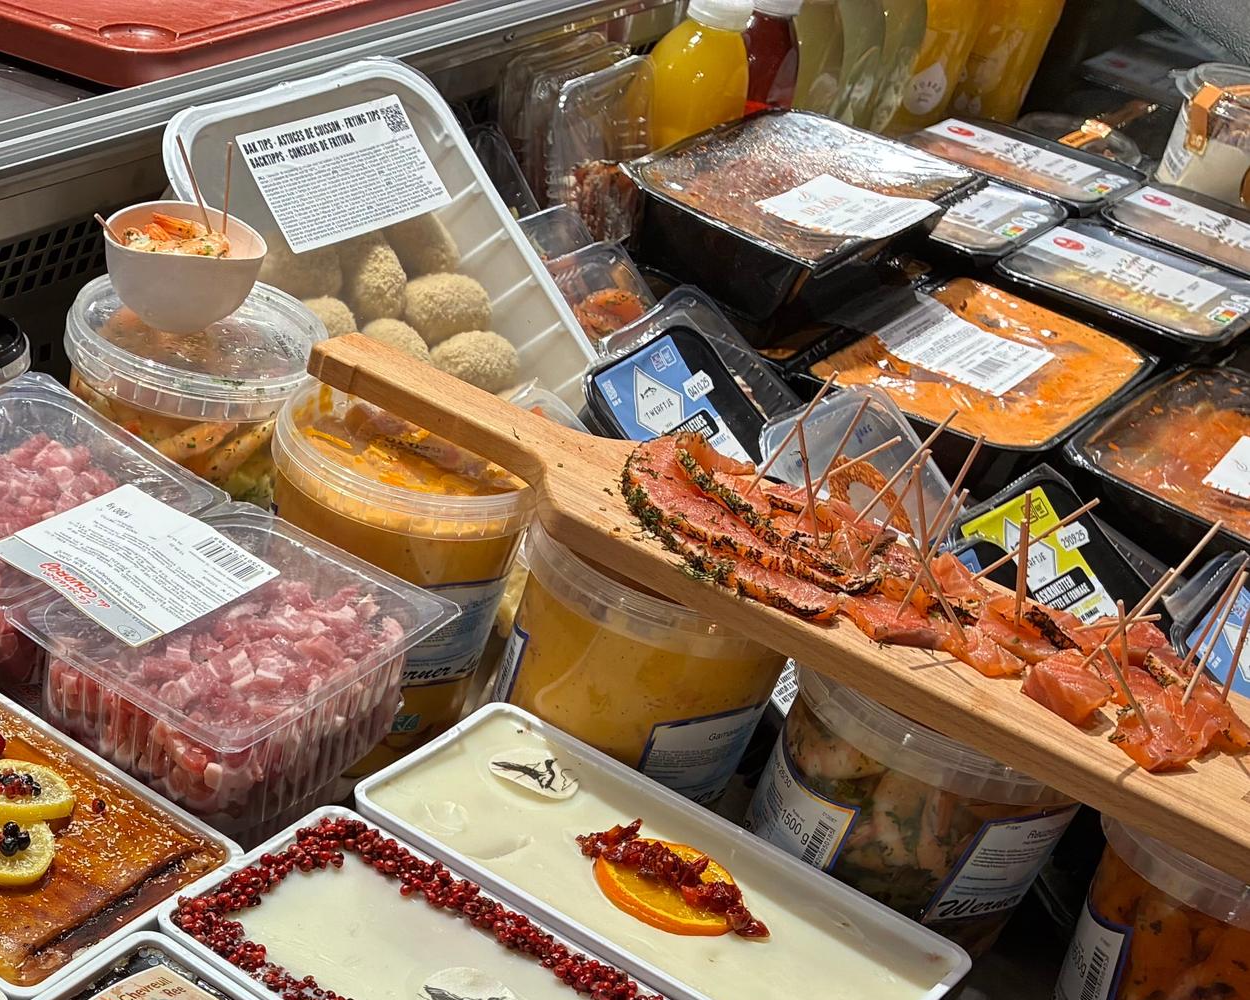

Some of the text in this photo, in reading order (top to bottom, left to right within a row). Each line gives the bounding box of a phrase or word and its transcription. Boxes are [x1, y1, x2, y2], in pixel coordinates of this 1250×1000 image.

[256, 138, 274, 151] TIPS
[274, 129, 305, 146] ASTUCES
[302, 127, 314, 138] DE
[312, 120, 342, 136] CUISSON
[342, 113, 368, 128] FRYING
[364, 109, 382, 122] TIPS
[248, 131, 356, 170] BACKTIPPS CONSEJOS DE FRITURA
[781, 809, 809, 845] 1500 g
[165, 985, 187, 998] Ree
